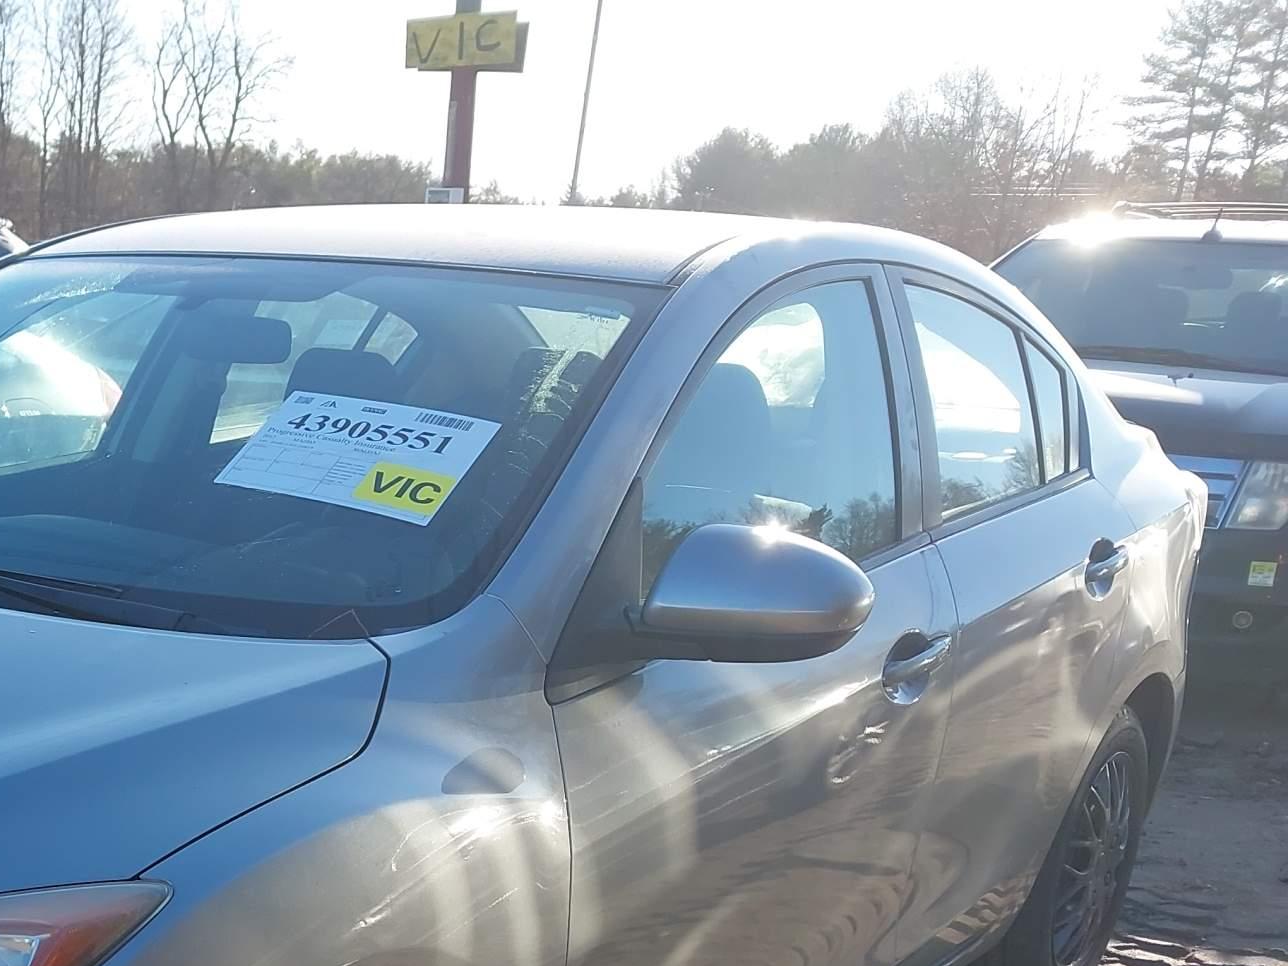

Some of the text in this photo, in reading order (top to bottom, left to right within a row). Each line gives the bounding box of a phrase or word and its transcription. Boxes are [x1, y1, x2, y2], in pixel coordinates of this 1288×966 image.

[412, 18, 501, 64] VIC
[287, 412, 454, 455] 43905551
[372, 471, 441, 505] VIC
